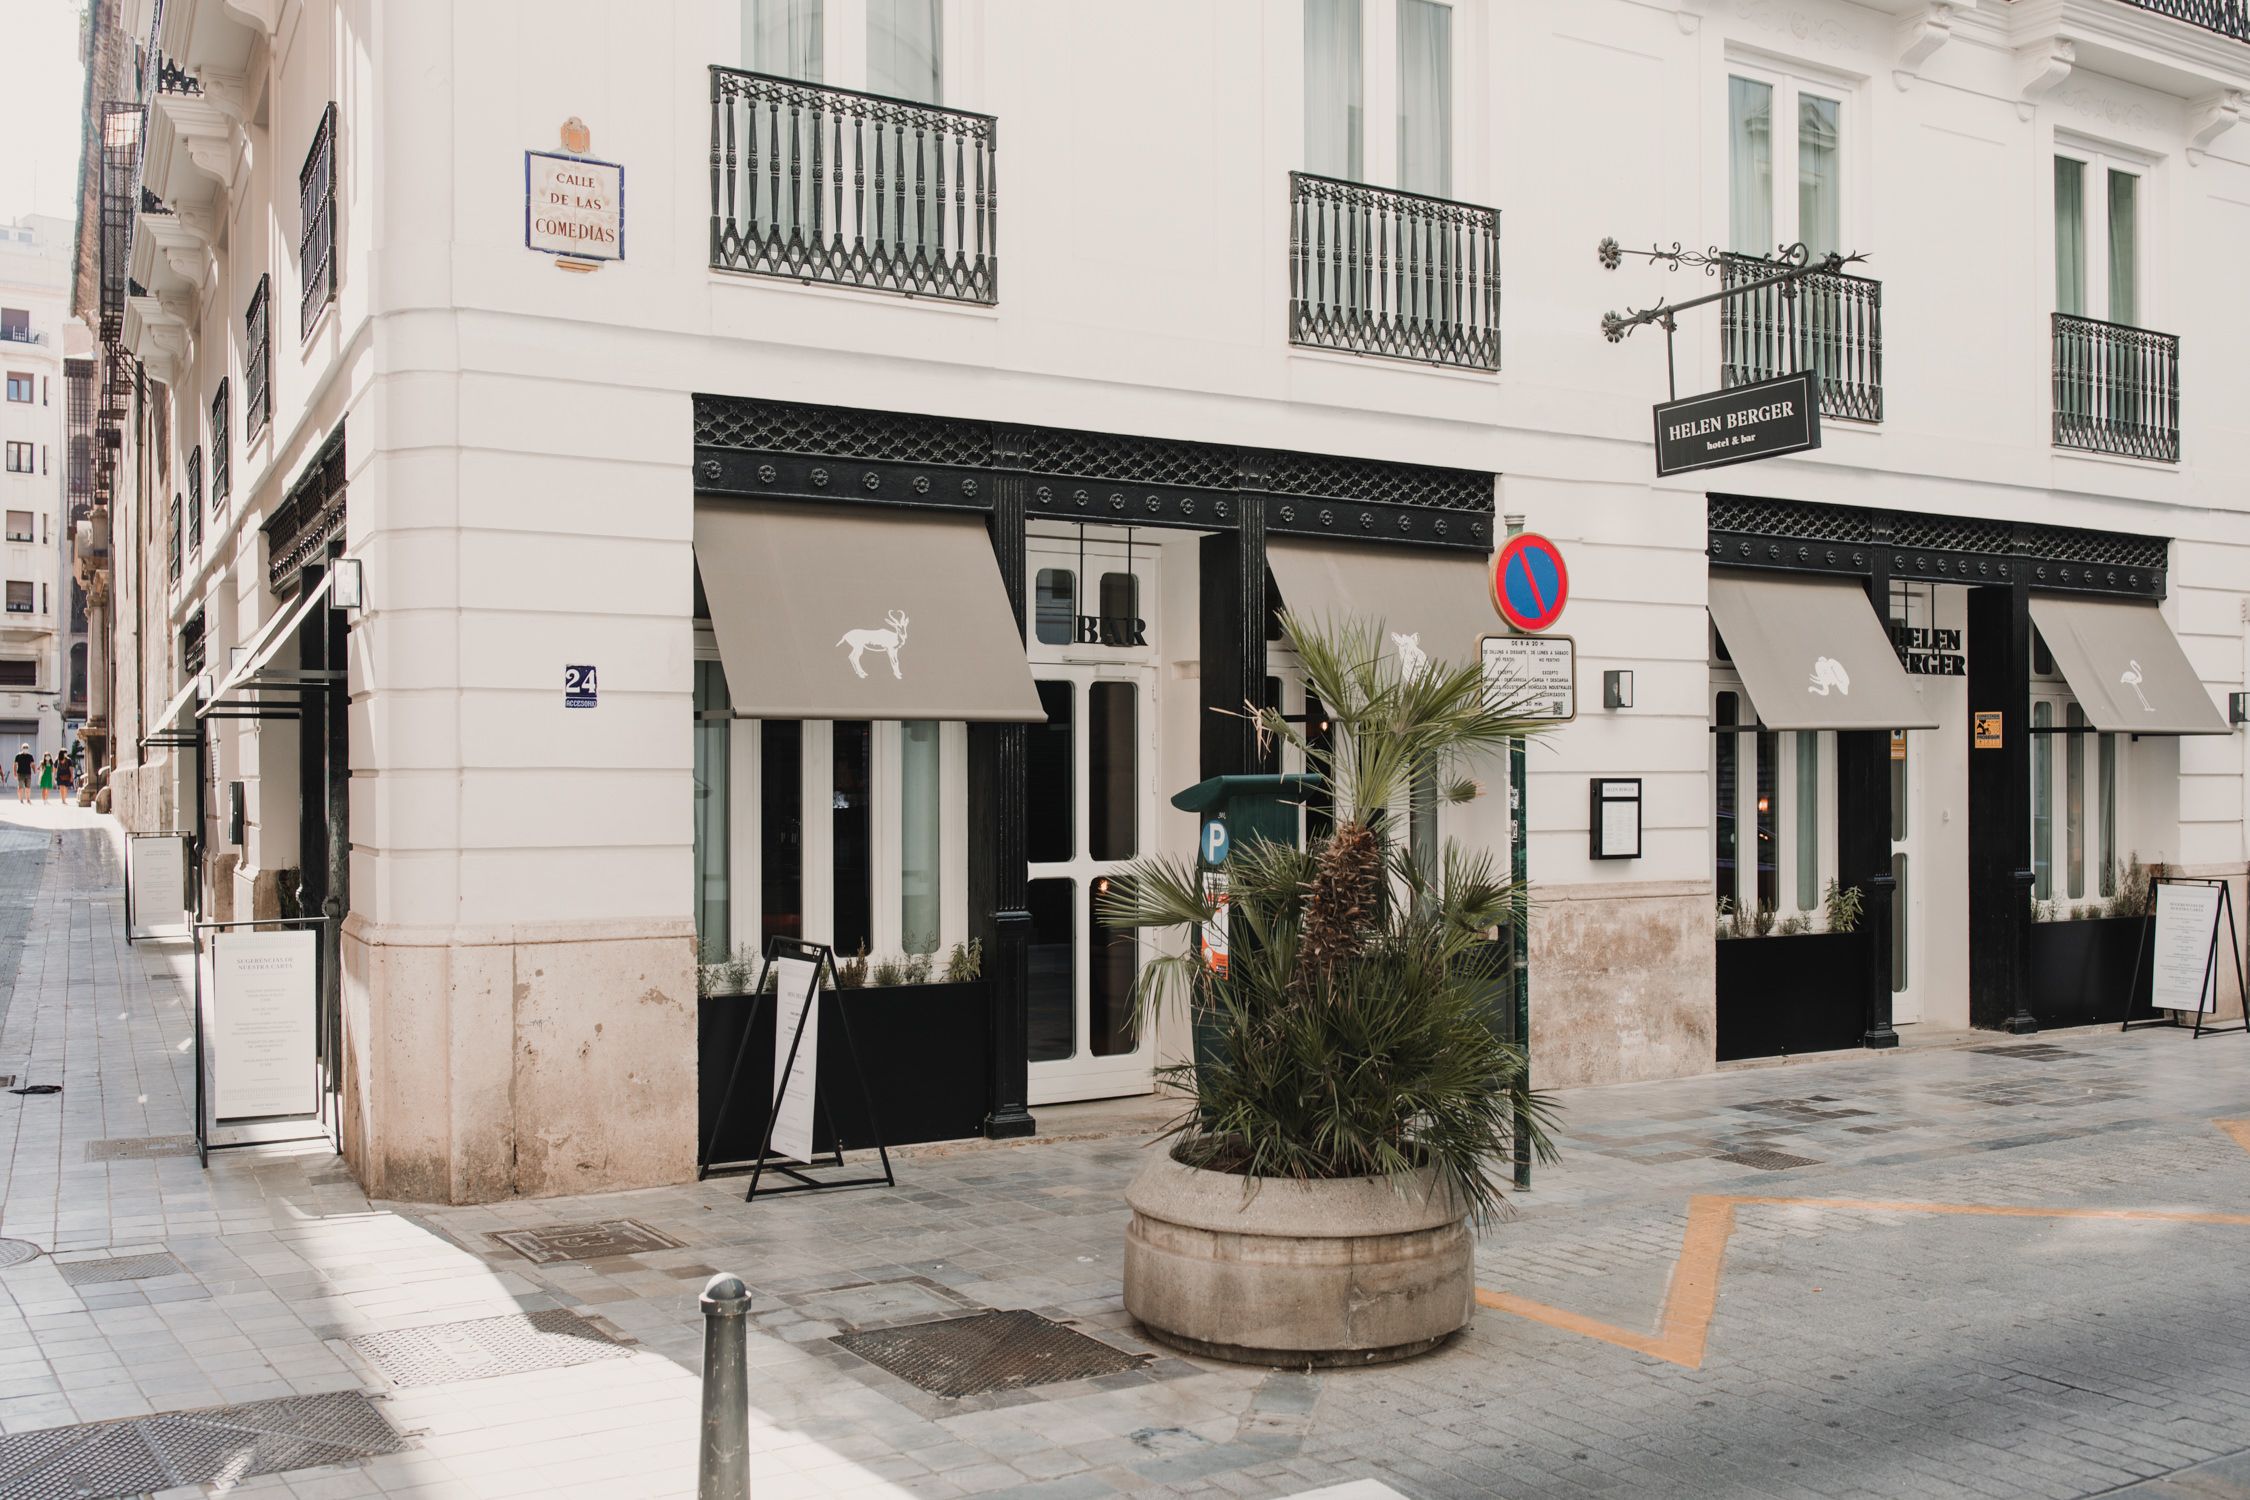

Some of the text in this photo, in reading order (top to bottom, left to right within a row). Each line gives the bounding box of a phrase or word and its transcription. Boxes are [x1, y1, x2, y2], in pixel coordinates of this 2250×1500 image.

[556, 172, 596, 188] CALLE
[550, 193, 602, 210] DE LAS
[536, 218, 615, 243] COMEDIAS
[1669, 401, 1794, 442] HELEN BERGER
[1706, 433, 1756, 450] hotel & bar
[1075, 616, 1148, 646] BAR
[1891, 627, 1961, 650] HELEN
[1898, 654, 1966, 676] ERGER
[566, 668, 596, 694] 24
[1209, 823, 1225, 862] P
